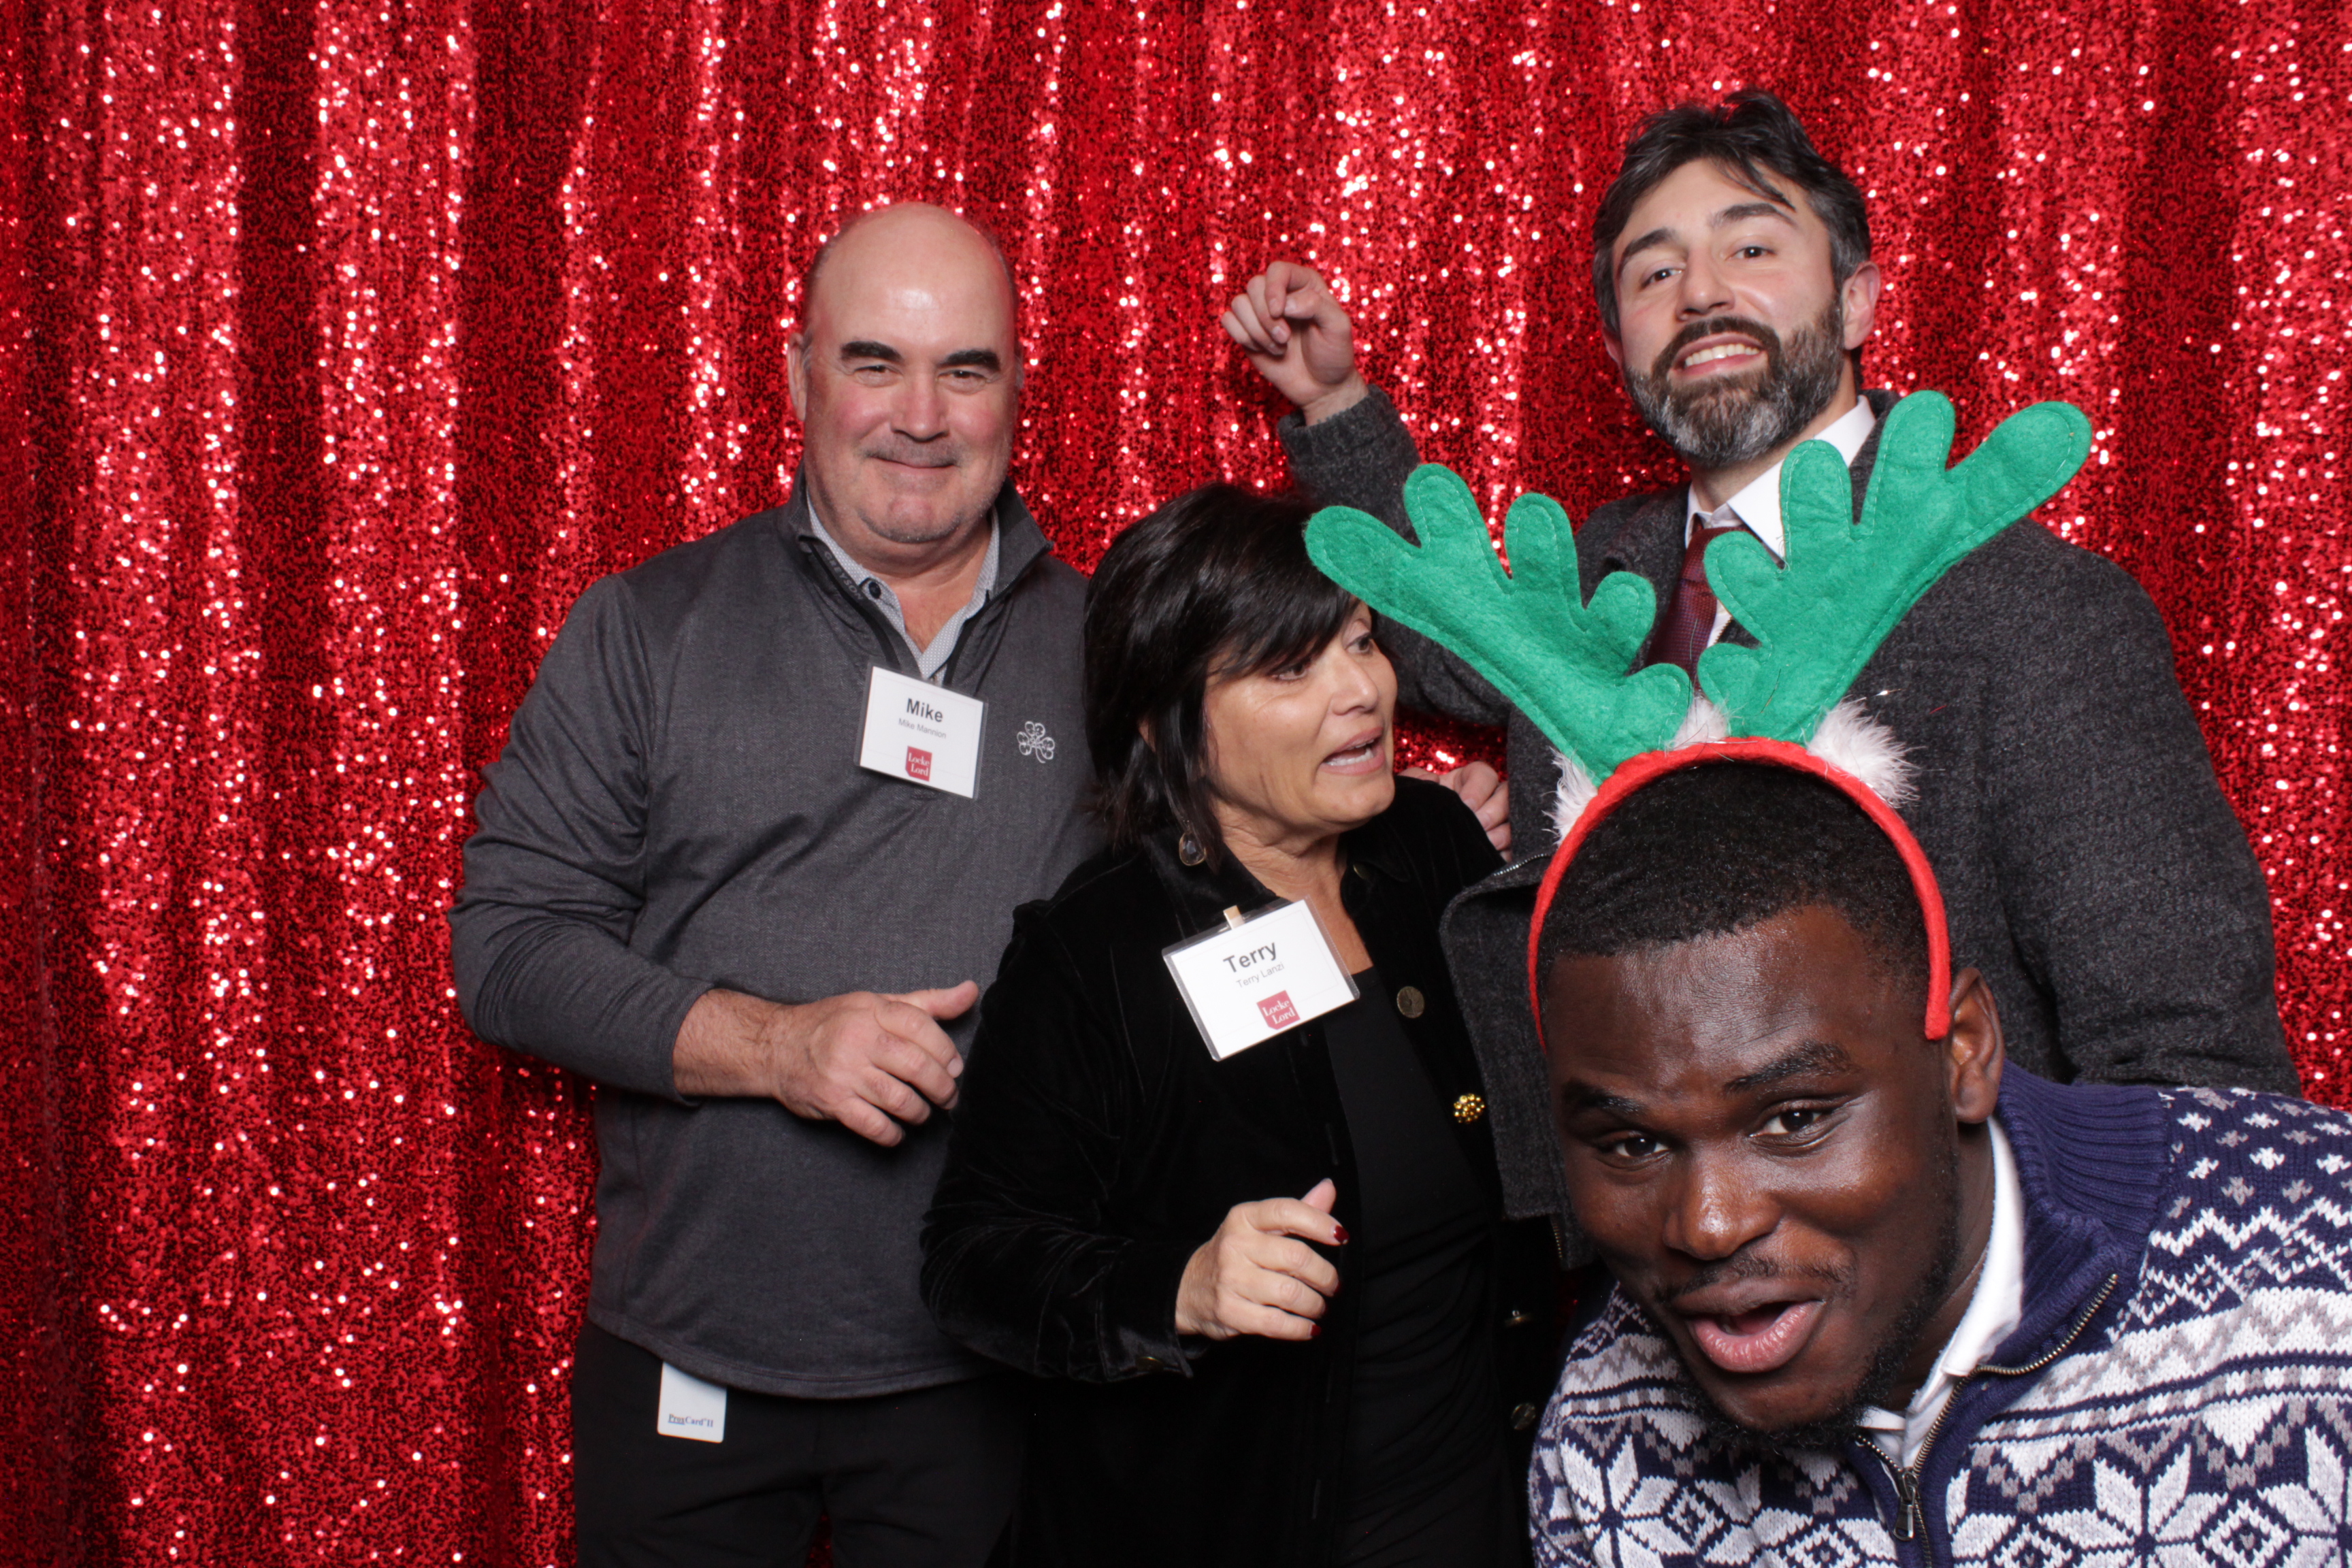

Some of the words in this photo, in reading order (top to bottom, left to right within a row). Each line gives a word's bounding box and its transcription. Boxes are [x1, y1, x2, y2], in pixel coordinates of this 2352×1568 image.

[824, 551, 864, 600] GREYSON
[906, 698, 943, 723] Mike
[898, 718, 915, 730] Mike
[917, 723, 947, 739] Mannion
[908, 752, 930, 766] Locke
[911, 764, 929, 777] Lord
[1222, 942, 1277, 973] Terry
[1236, 973, 1260, 988] Terry
[1260, 962, 1285, 978] Lanzi
[1262, 999, 1290, 1017] Locke
[1271, 1007, 1296, 1025] Lord
